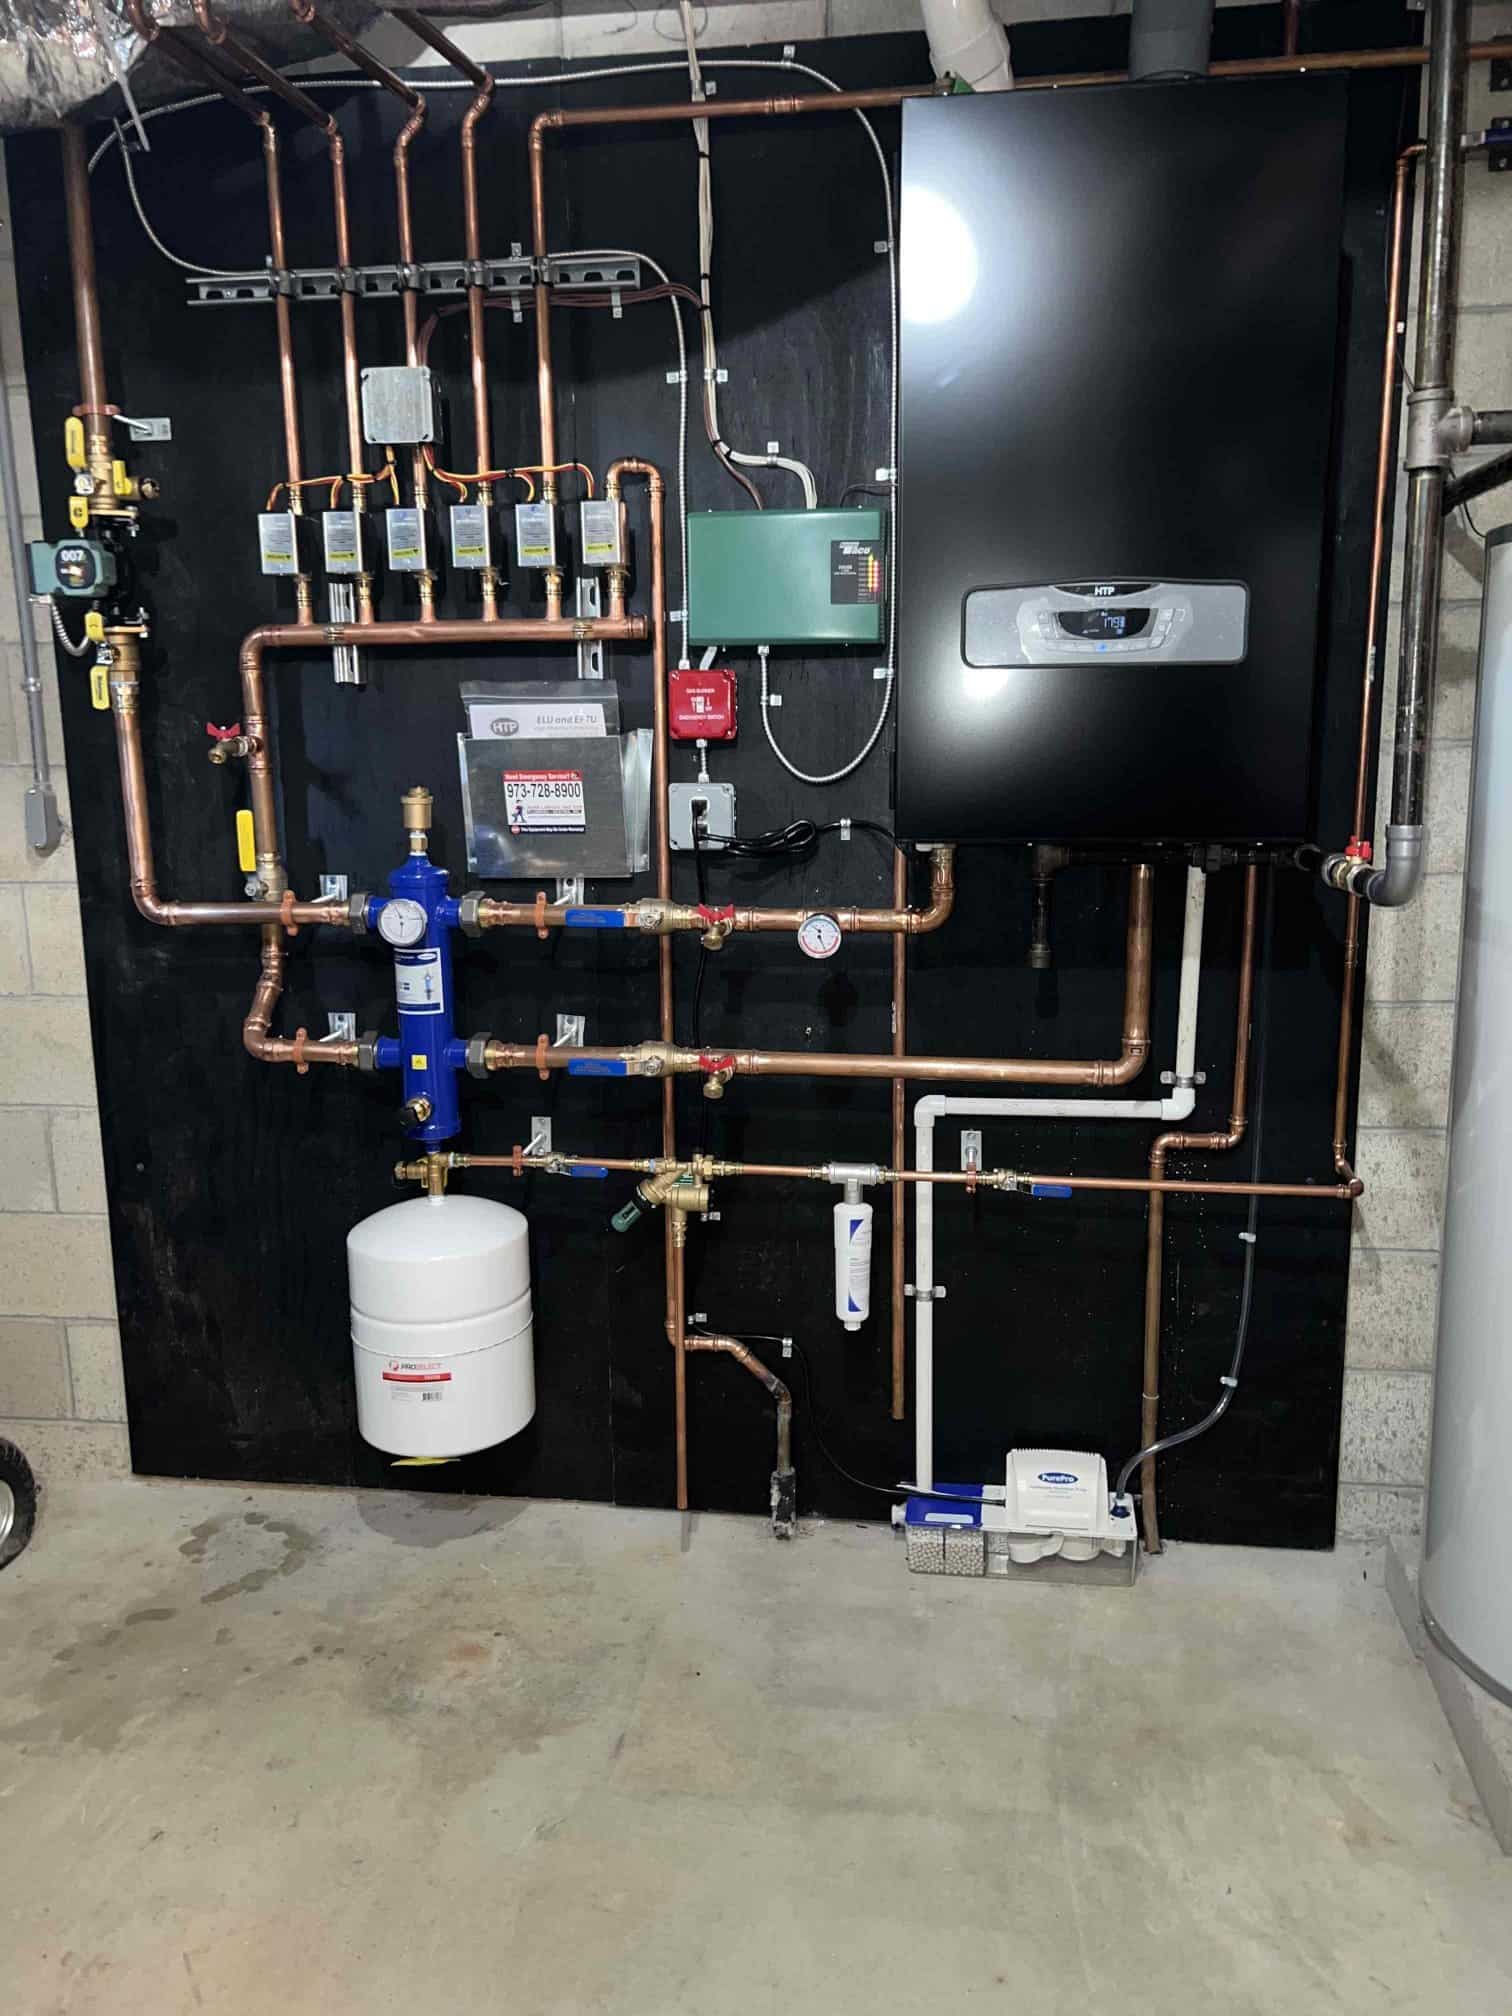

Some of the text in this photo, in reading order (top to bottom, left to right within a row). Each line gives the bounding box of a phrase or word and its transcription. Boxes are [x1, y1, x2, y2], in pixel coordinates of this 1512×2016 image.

[840, 542, 870, 554] Taco
[60, 549, 84, 561] 007
[1094, 586, 1115, 596] HTP
[555, 714, 573, 724] and
[493, 721, 517, 734] HTP
[519, 773, 547, 782] Emergency
[507, 783, 581, 798] 973-728-8900
[400, 1361, 442, 1370] PROSELECT
[1042, 1474, 1075, 1483] PurePro
